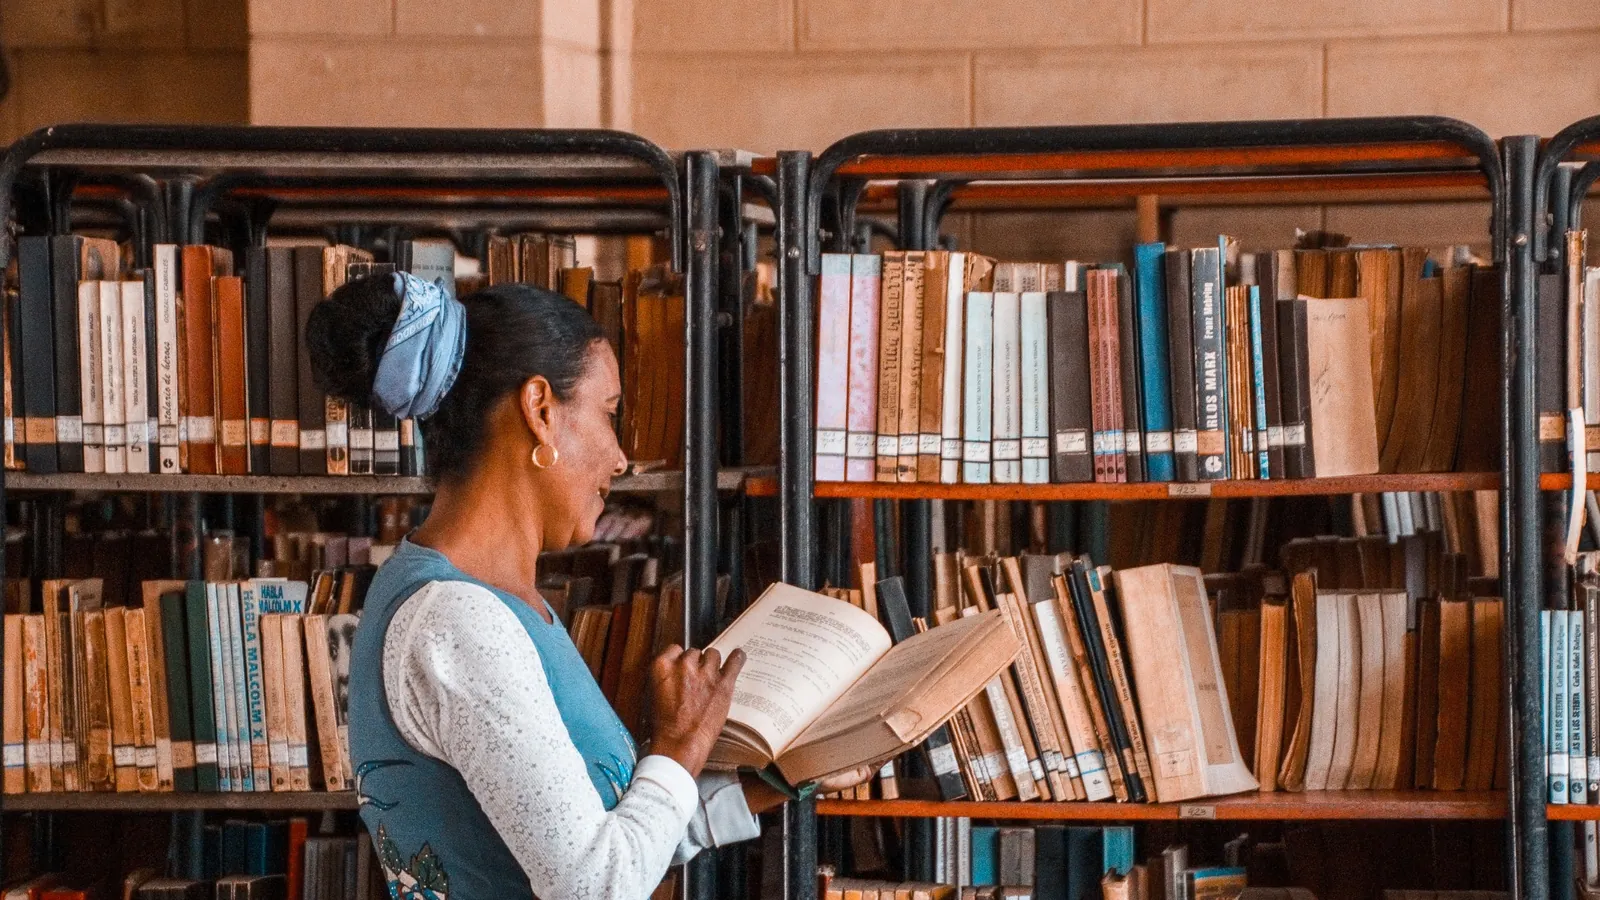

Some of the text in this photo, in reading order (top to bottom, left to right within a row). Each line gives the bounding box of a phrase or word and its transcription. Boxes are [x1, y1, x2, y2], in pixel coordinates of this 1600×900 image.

[1203, 282, 1214, 340] Franz Mehring
[162, 375, 171, 386] de
[1204, 352, 1216, 390] MARX
[163, 388, 172, 425] stolario
[1206, 395, 1218, 431] RLOS
[261, 585, 284, 599] HABLA
[258, 600, 302, 613] MALCOLM X
[1105, 623, 1117, 648] elefante
[244, 590, 262, 738] HABLA MALCOLM X
[1572, 652, 1580, 669] Rafael
[1114, 658, 1126, 690] memoria
[1572, 692, 1580, 718] SETENTA
[1555, 720, 1563, 731] LOS
[1572, 720, 1580, 730] LOS
[1572, 732, 1580, 740] EN
